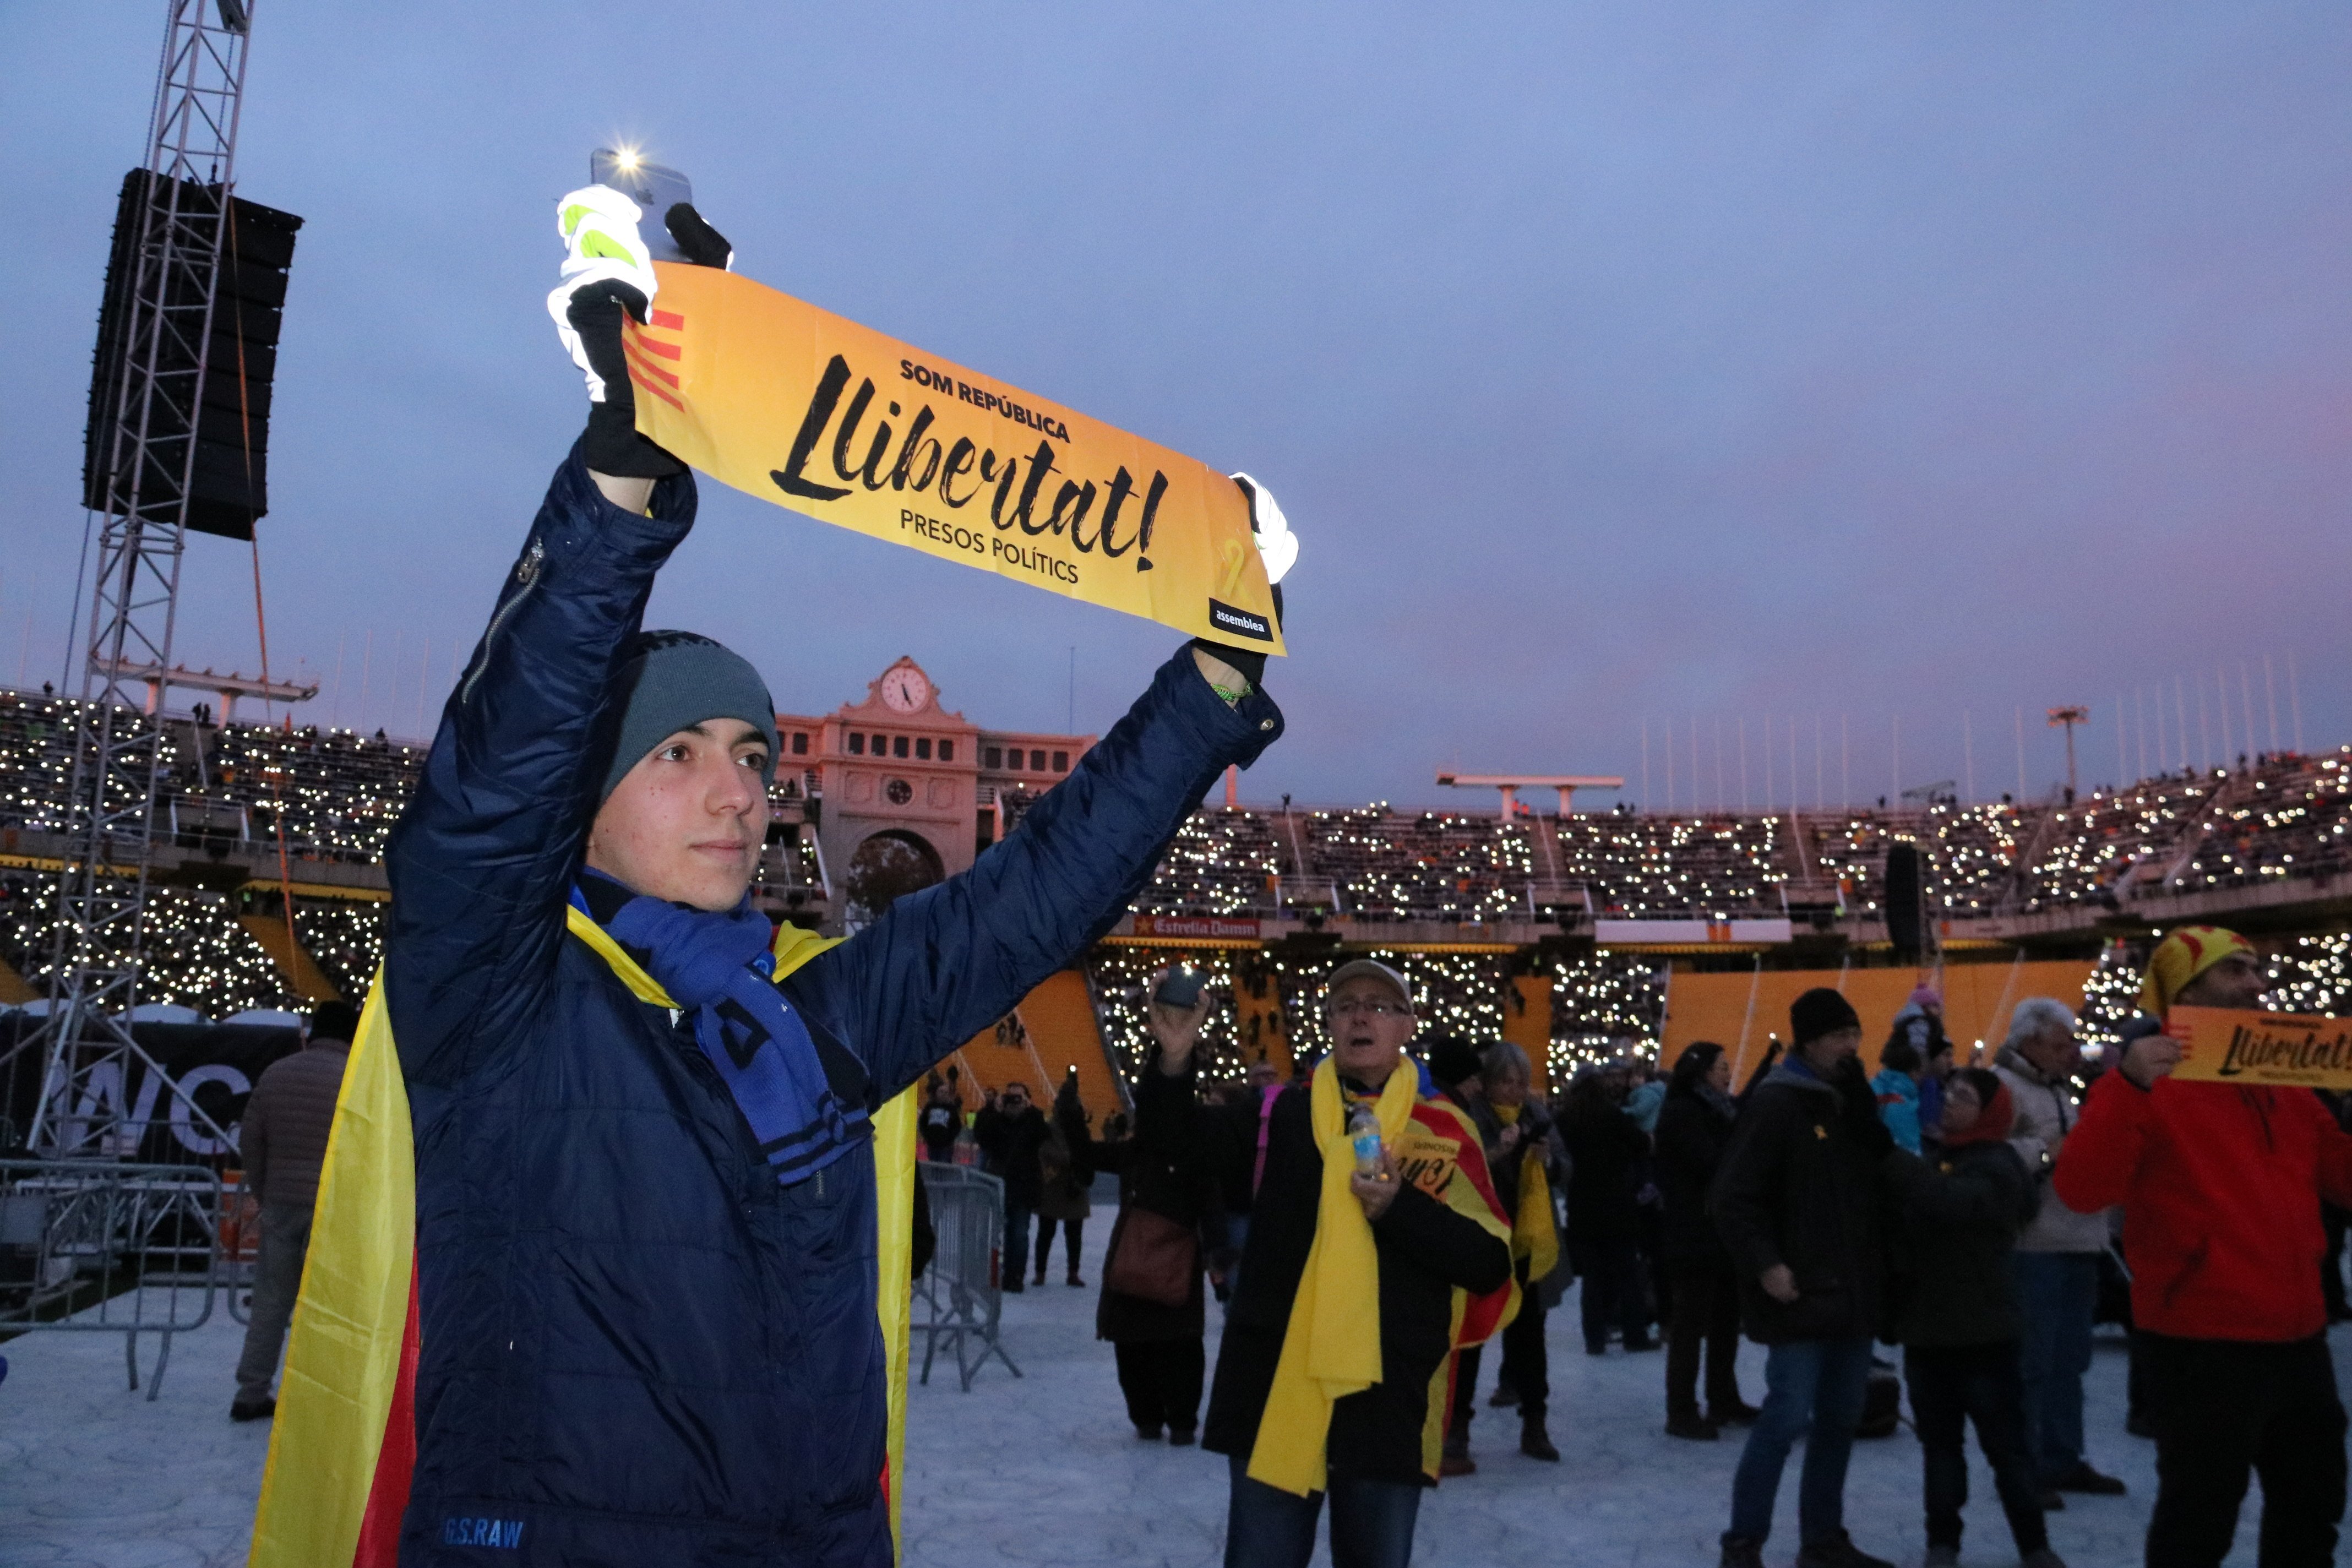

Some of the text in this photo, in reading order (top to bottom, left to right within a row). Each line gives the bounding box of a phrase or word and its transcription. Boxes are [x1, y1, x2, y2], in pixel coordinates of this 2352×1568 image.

[900, 359, 1071, 443] SOM REPÚBLICA
[769, 353, 1168, 574] Llibertat!
[900, 508, 1079, 584] PRESOS POLÍTICS
[1216, 609, 1265, 633] assemblea
